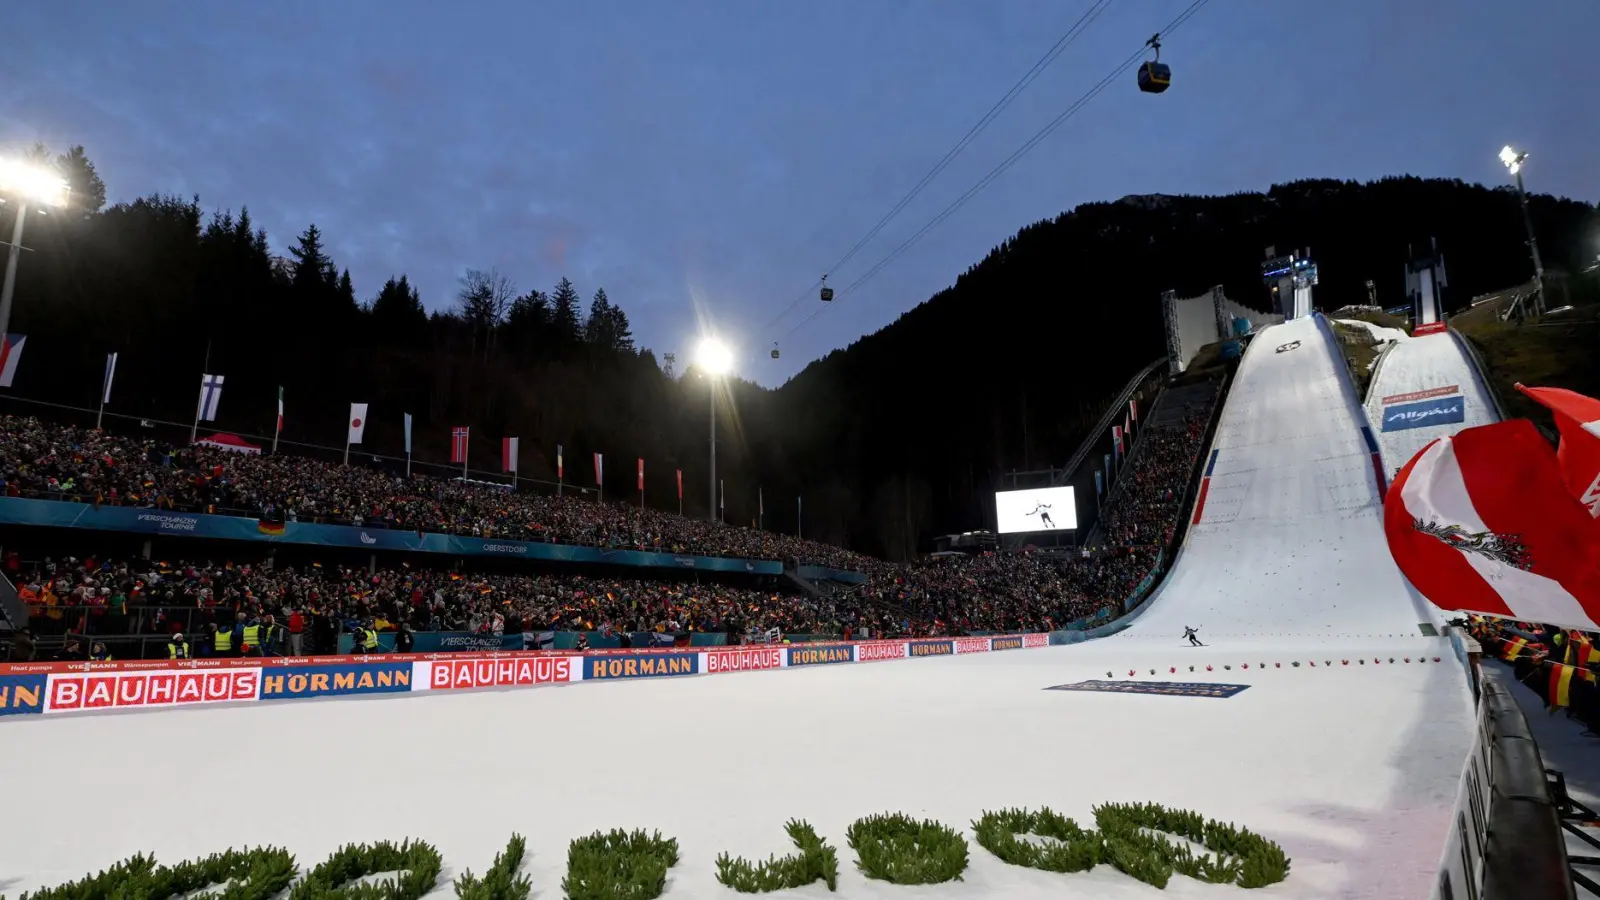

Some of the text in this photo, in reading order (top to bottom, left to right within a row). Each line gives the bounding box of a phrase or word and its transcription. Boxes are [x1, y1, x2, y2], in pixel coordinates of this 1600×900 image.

[483, 544, 528, 554] OBERSTDORF
[441, 636, 504, 646] VIERSCHANZEN
[912, 643, 951, 655] HÖRMANN
[957, 640, 989, 653] BAUHAUS
[792, 648, 850, 664] HÖRMANN
[860, 645, 905, 659] BAUHAUS
[593, 657, 692, 678] HÖRMANN
[709, 652, 779, 670] BAUHAUS
[264, 669, 410, 693] HÖRMANN
[434, 661, 569, 686] BAUHAUS
[55, 675, 254, 705] BAUHAUS
